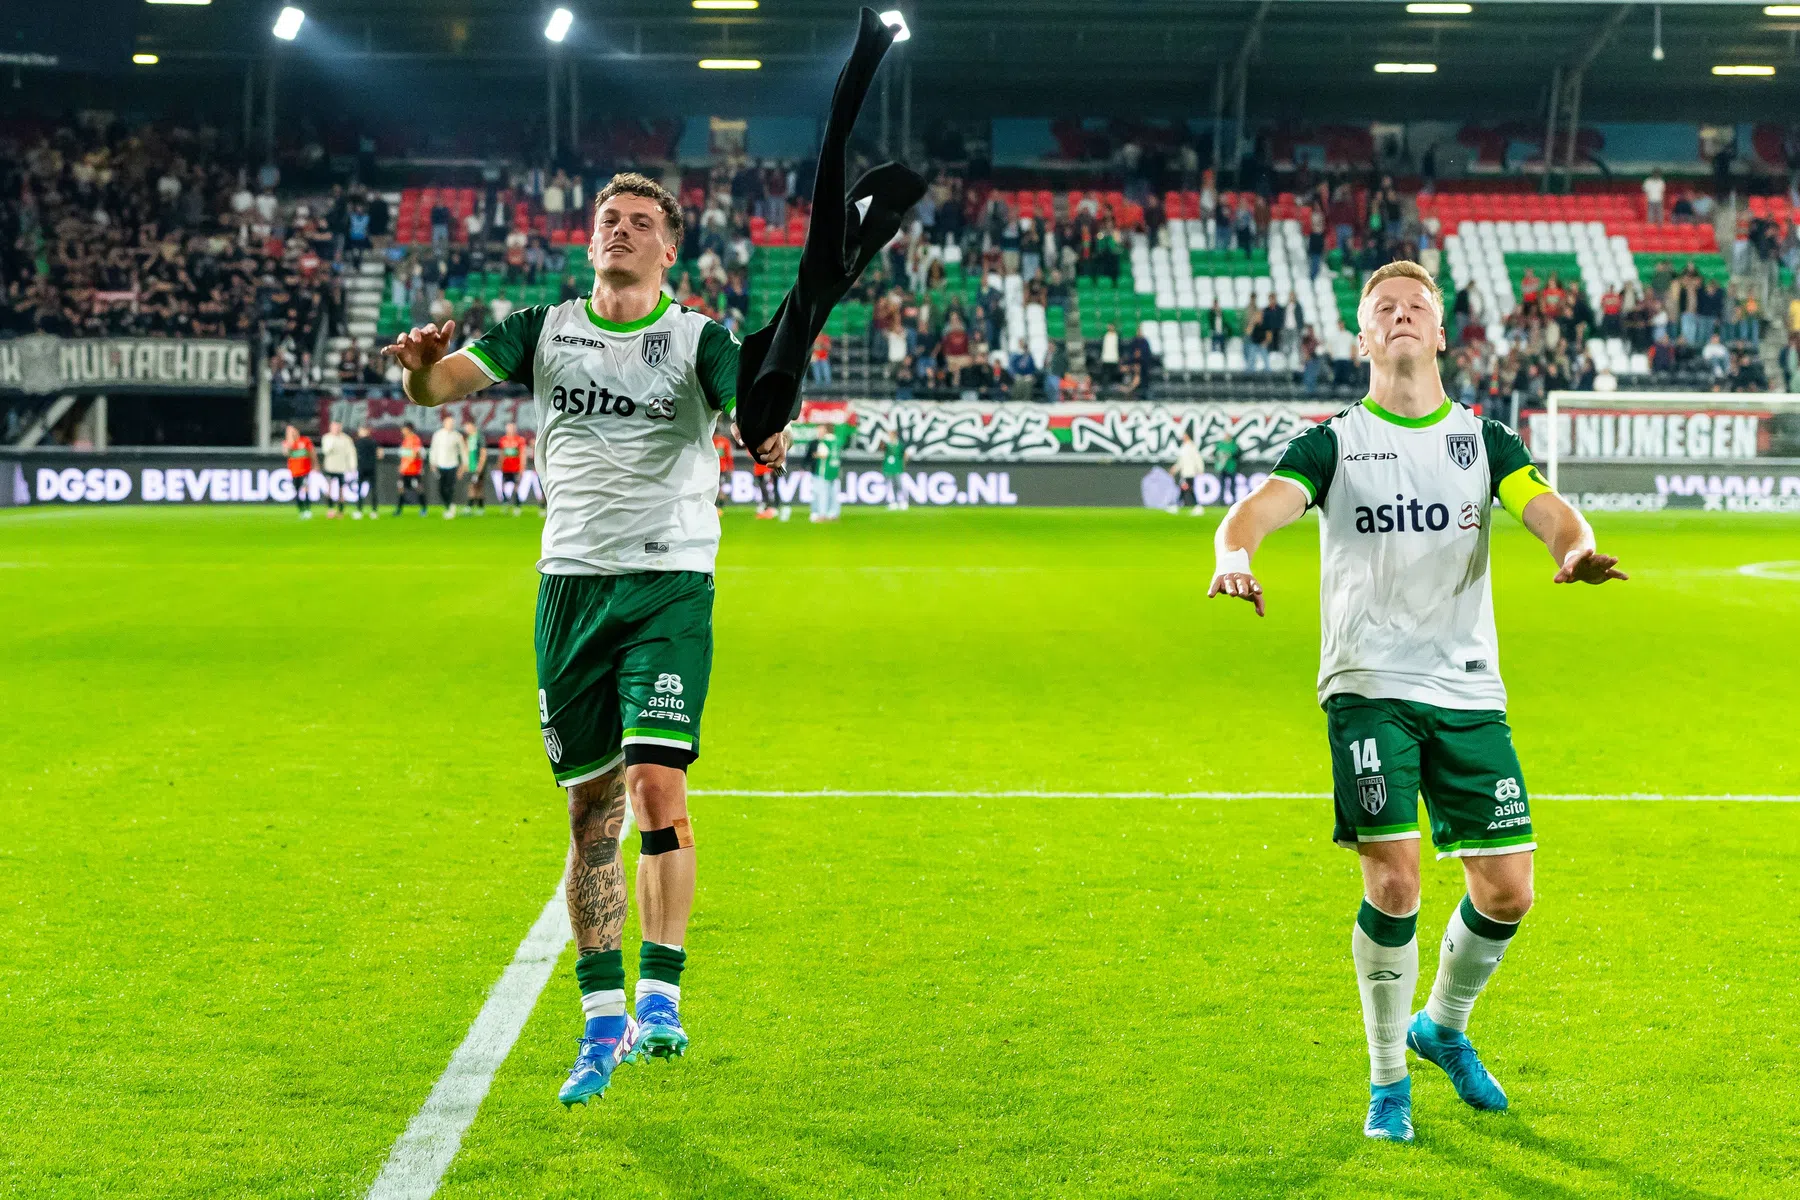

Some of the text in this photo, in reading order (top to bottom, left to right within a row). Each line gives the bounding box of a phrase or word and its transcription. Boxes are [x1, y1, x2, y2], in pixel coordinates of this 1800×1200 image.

[552, 380, 636, 417] asito
[1575, 413, 1759, 459] NIJMEGEN
[37, 467, 132, 502] DGSD
[1355, 494, 1450, 534] asito
[648, 694, 685, 710] asito
[1349, 738, 1381, 775] 14
[1494, 800, 1525, 817] asito
